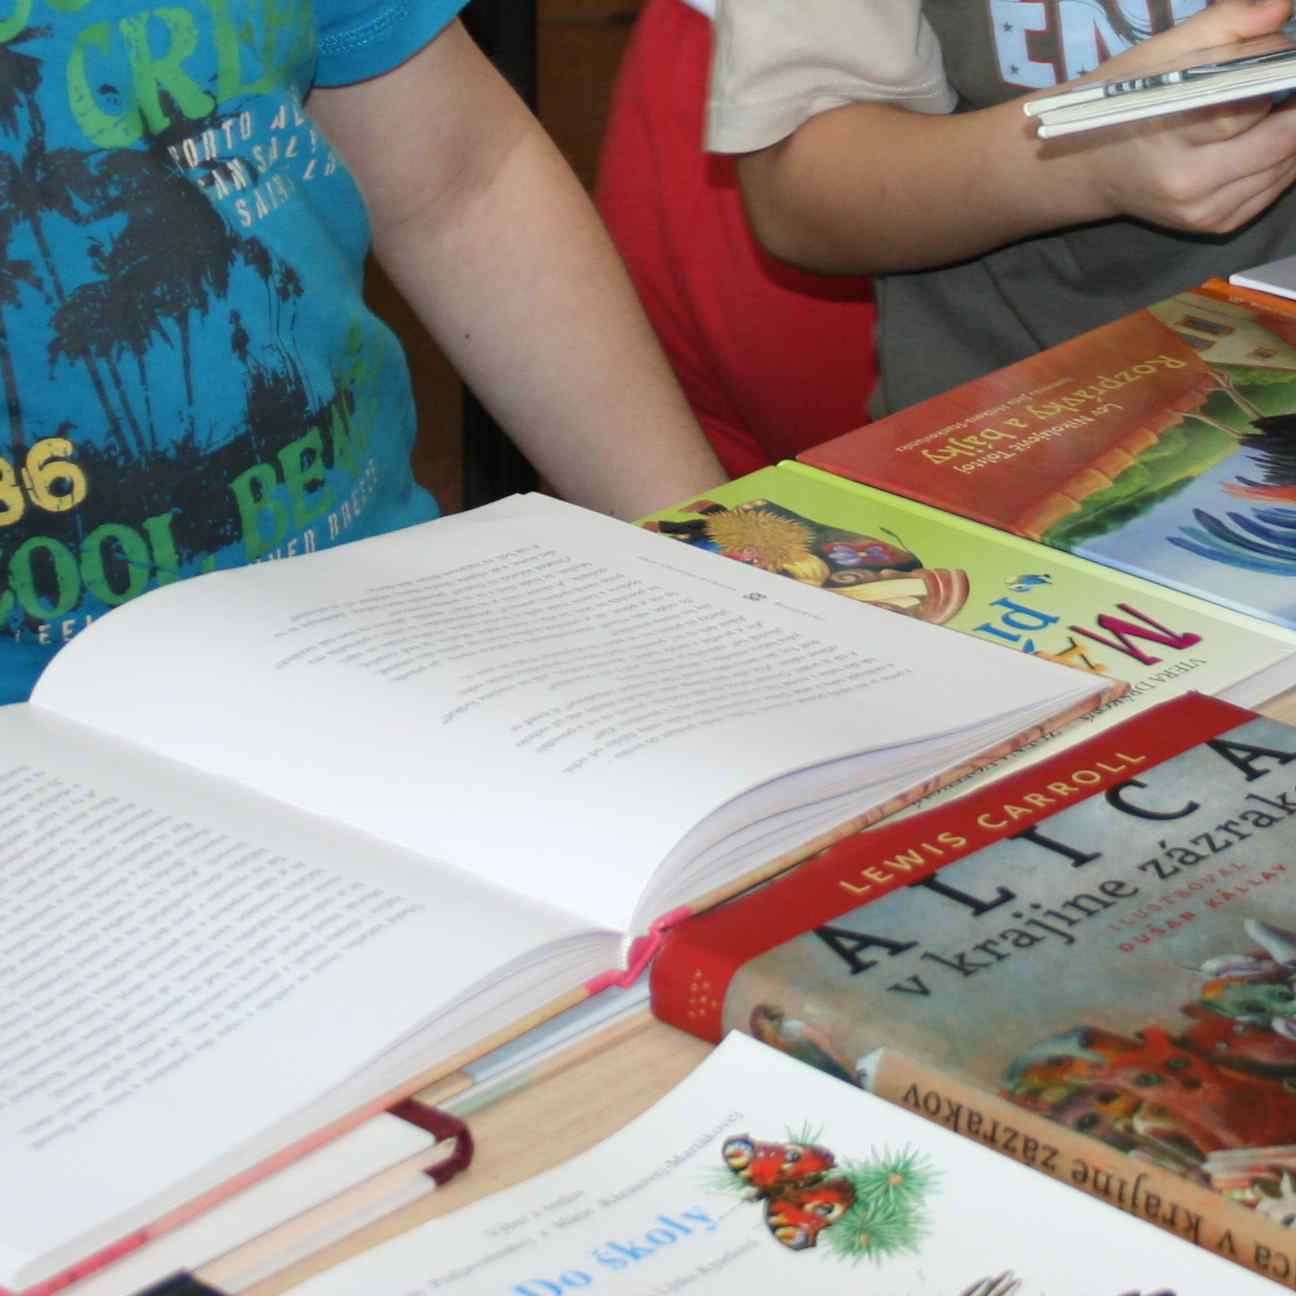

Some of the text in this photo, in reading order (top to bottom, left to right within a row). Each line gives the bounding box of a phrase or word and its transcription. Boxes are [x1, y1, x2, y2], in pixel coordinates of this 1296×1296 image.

[1025, 353, 1188, 423] Rozprávky
[919, 425, 1017, 467] bájky
[840, 830, 968, 896] LEWIS
[977, 753, 1147, 830] CARROLL
[887, 974, 932, 1001] v
[922, 876, 1140, 978] krajine
[1118, 909, 1198, 955] DUŠAN
[901, 1083, 1060, 1172] zázrakov
[1070, 1156, 1201, 1248] krajine
[591, 1204, 719, 1271] školy
[1216, 1229, 1239, 1255] v
